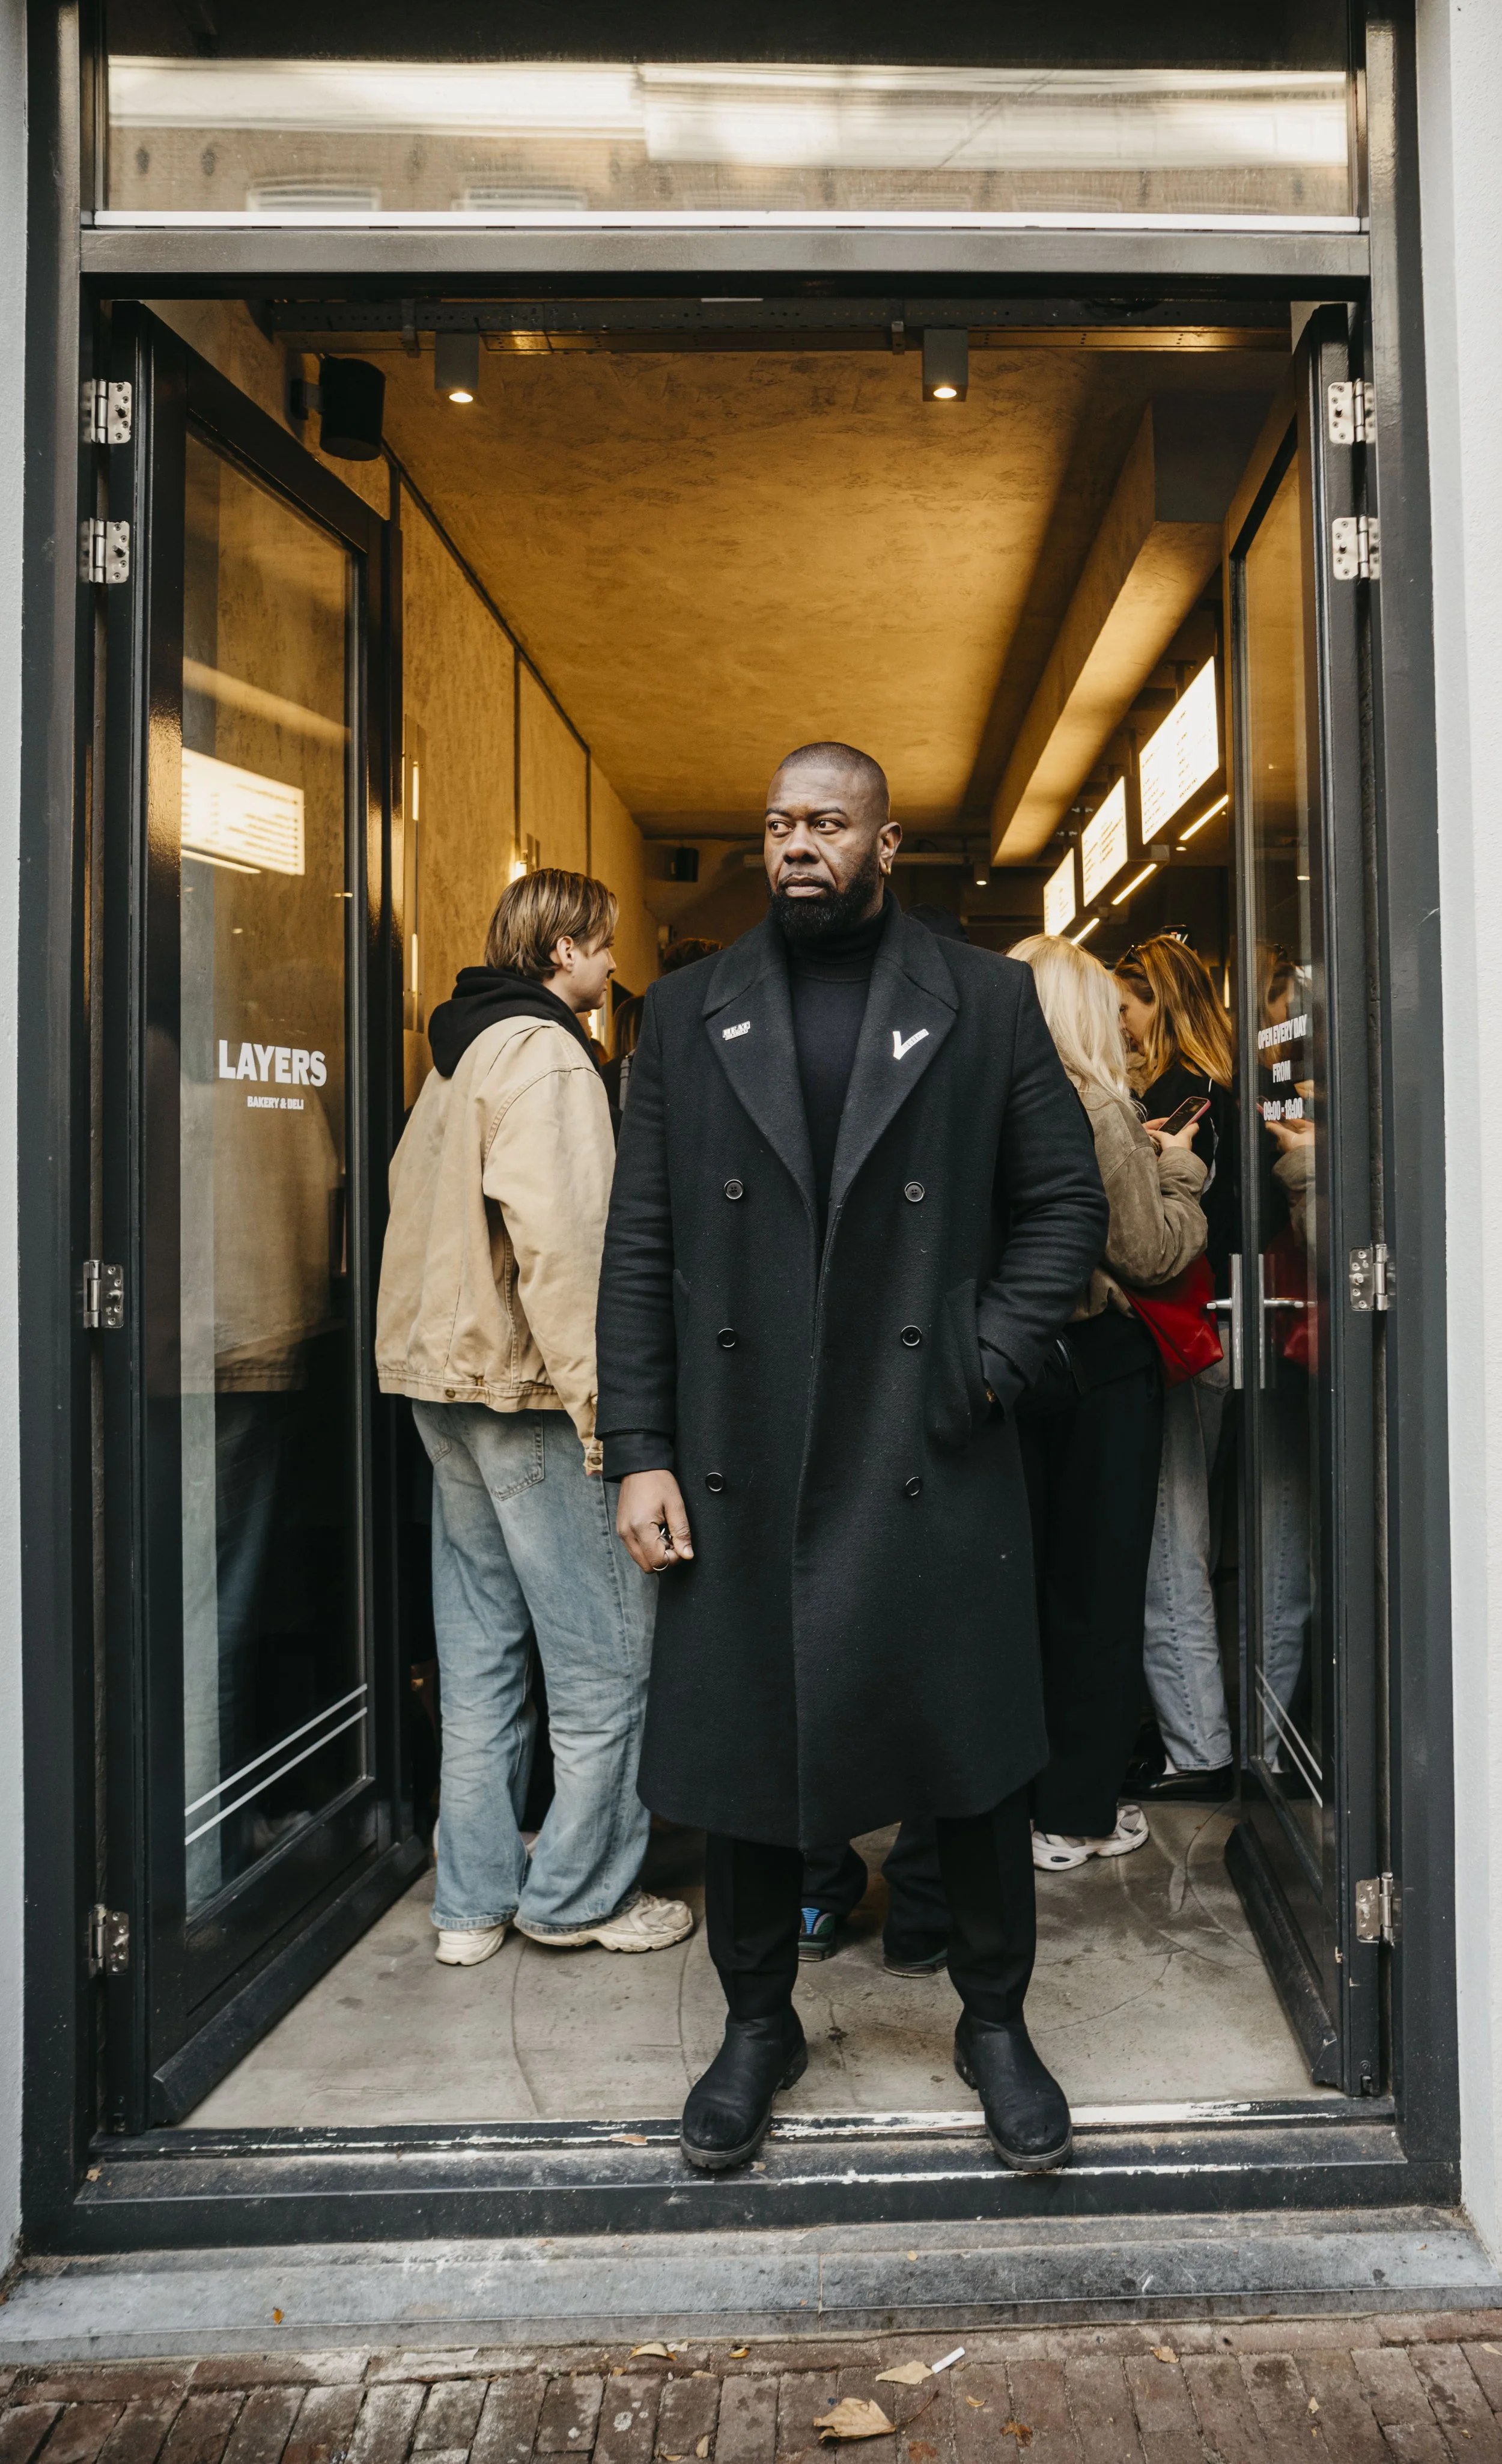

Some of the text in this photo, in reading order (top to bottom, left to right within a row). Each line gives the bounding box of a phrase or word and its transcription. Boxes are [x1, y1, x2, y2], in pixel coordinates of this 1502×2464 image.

[1258, 1014, 1307, 1050] OPEN EVERY DAY
[219, 1039, 327, 1087] LAYERS
[1272, 1060, 1291, 1083] FROM
[247, 1095, 304, 1110] BAKERY & DELI
[1263, 1101, 1280, 1121] 09:00
[1285, 1097, 1303, 1119] 18:00
